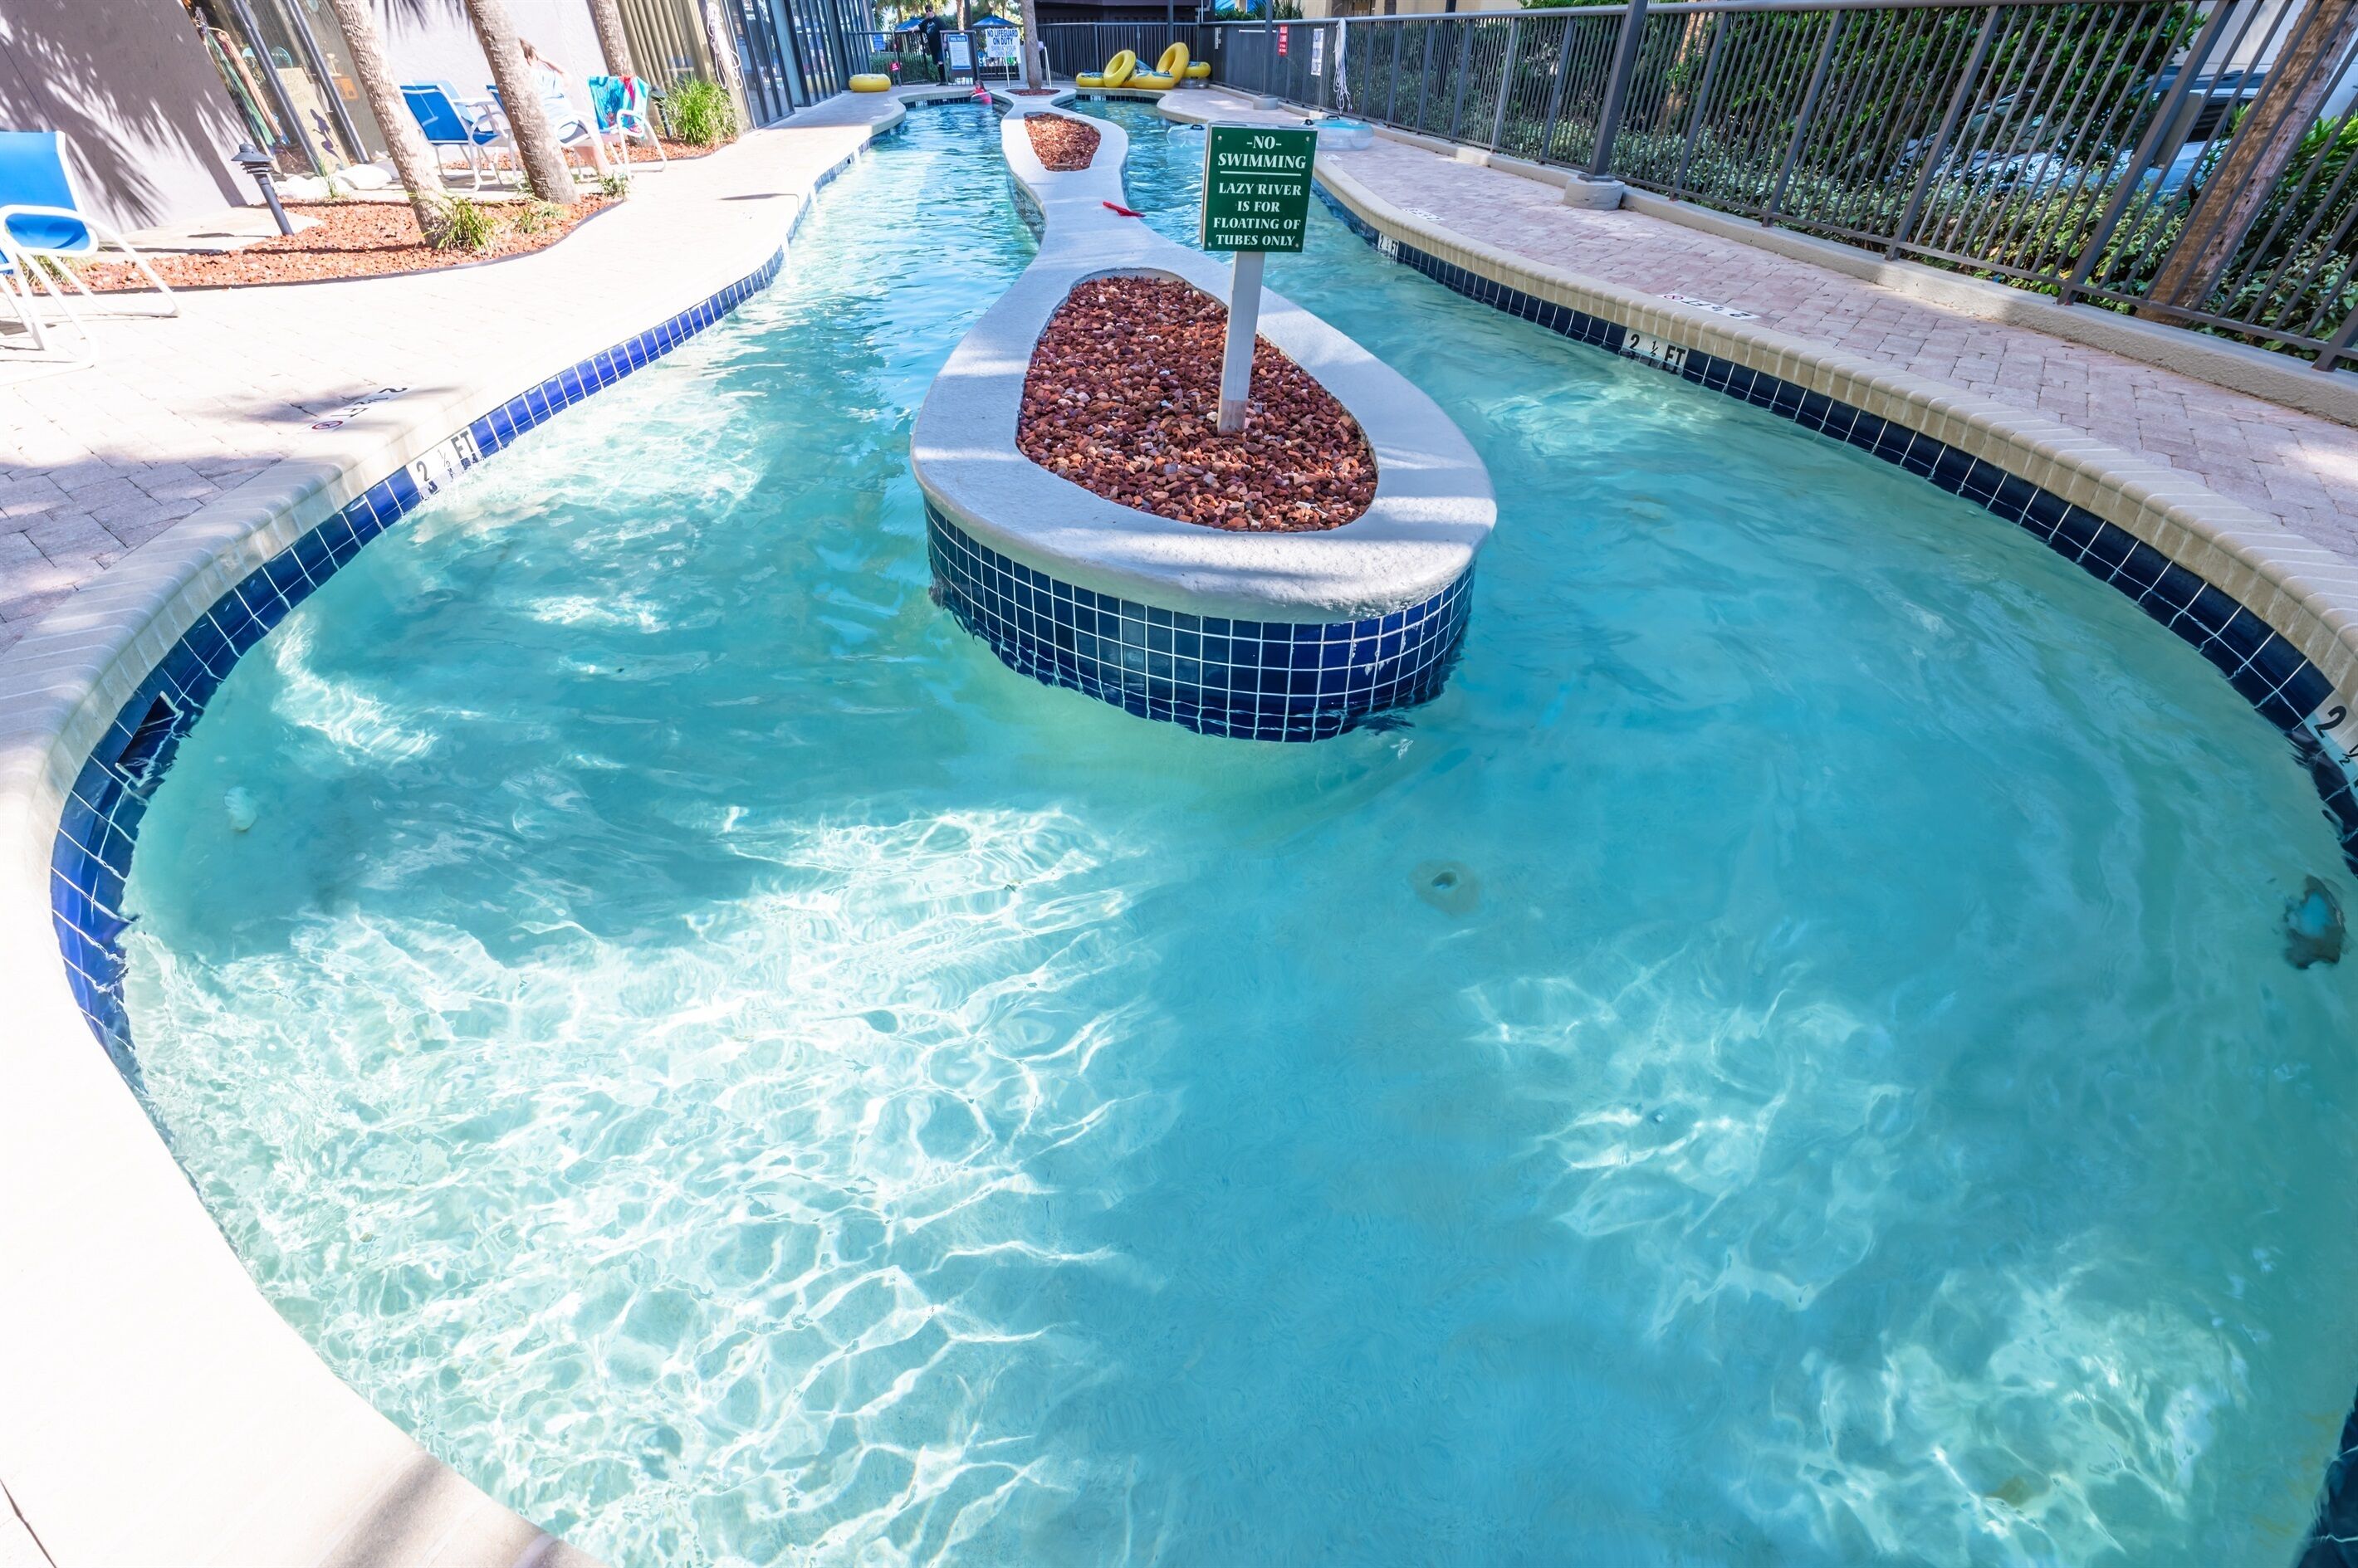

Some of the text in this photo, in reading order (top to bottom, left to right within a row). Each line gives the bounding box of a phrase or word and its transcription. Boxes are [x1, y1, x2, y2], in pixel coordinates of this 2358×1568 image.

[1001, 37, 1013, 46] DUTY
[1217, 153, 1306, 169] SWIMMING
[1218, 183, 1302, 196] LAZY RIVER
[1237, 201, 1280, 212] IS FOR
[1213, 217, 1301, 230] FLOATING OF
[1216, 234, 1295, 247] TUBES ONLY
[1630, 334, 1640, 349] 2
[1665, 344, 1686, 365] FT
[416, 461, 430, 481] 2
[450, 430, 474, 460] FT
[2314, 706, 2347, 739] 2
